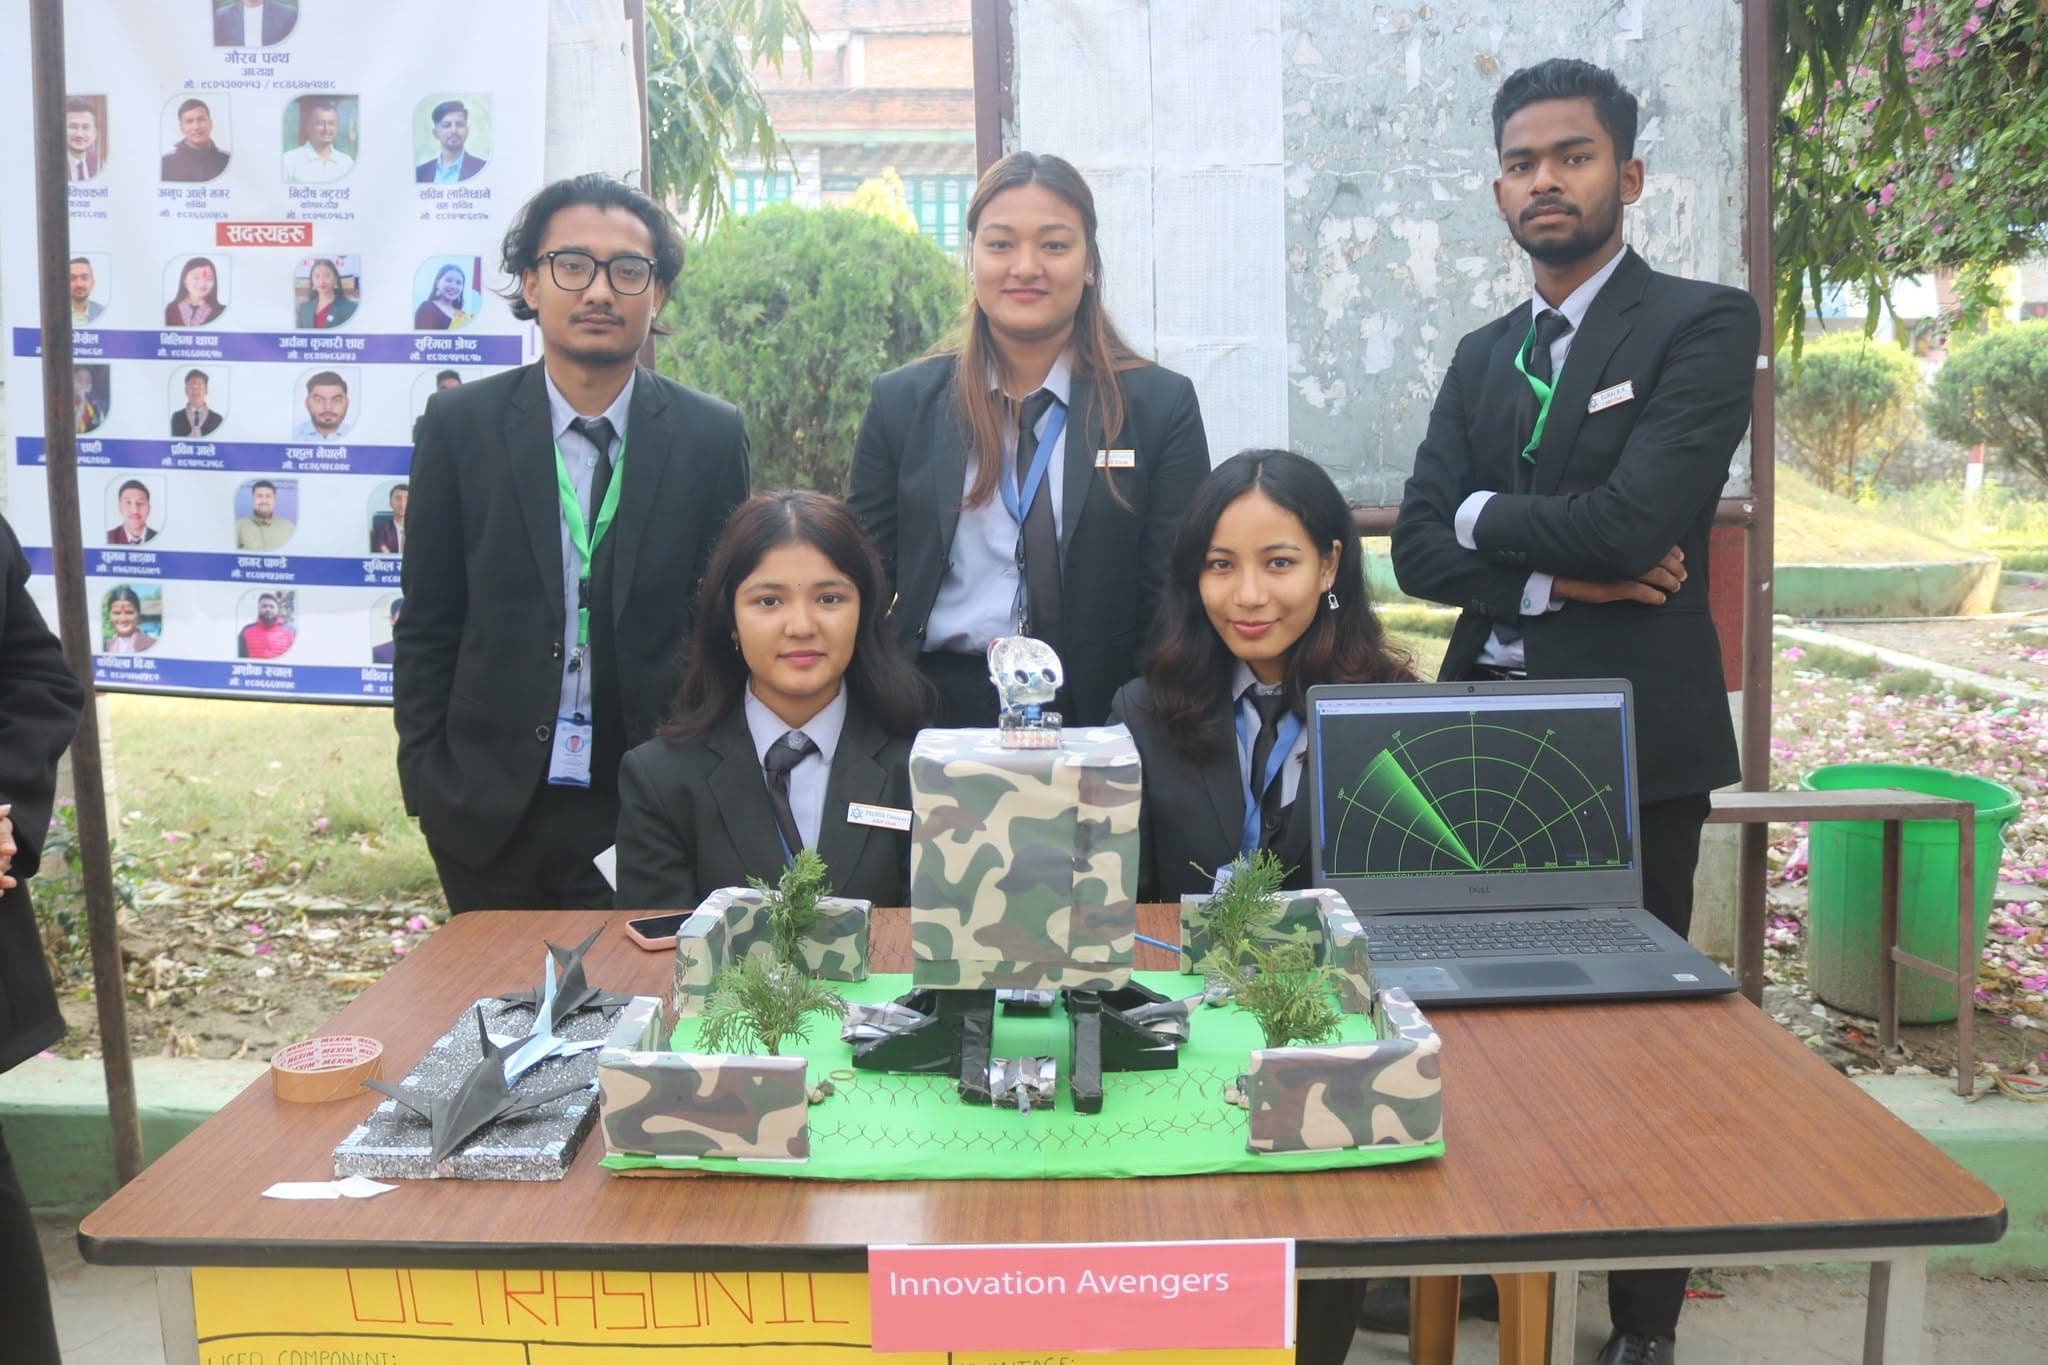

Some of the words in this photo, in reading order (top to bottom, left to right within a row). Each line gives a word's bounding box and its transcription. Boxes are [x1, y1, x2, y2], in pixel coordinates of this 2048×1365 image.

[224, 51, 257, 64] गौरव
[262, 52, 290, 64] पन्थ
[1469, 886, 1491, 894] DELL
[287, 1051, 314, 1063] MEXIM
[889, 1269, 1066, 1296] Innovation
[1077, 1269, 1230, 1300] Avengers
